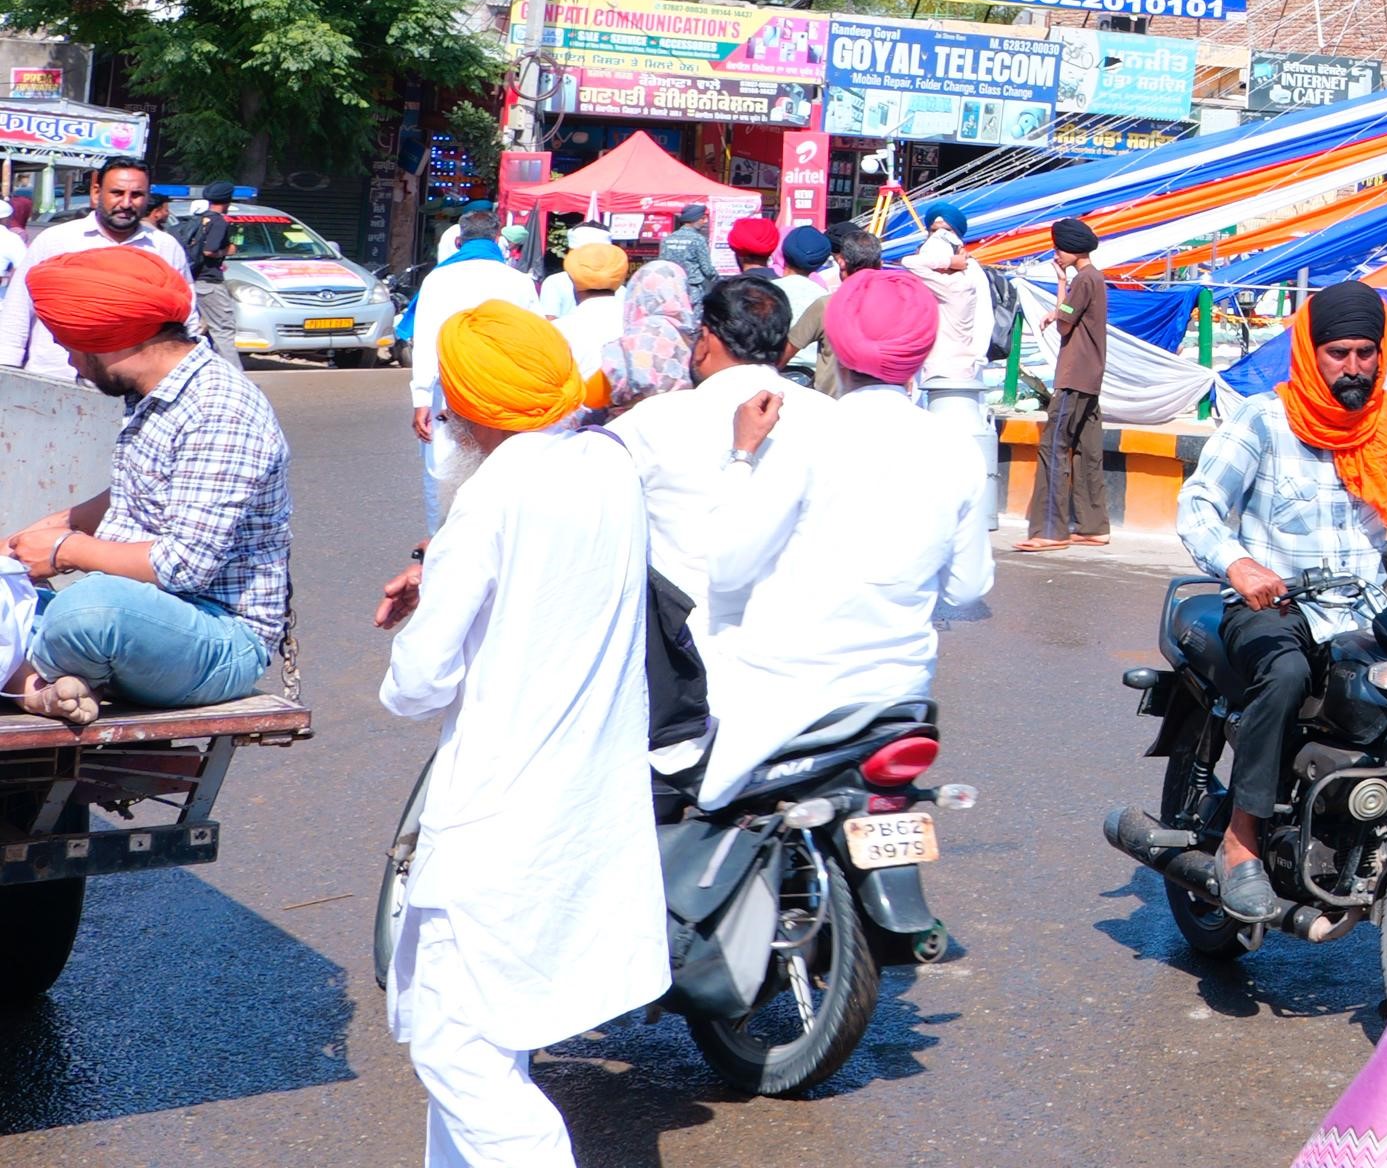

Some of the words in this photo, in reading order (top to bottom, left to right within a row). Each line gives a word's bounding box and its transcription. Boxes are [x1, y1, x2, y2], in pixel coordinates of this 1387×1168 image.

[520, 1, 589, 26] GNPATI
[593, 8, 741, 39] COMMUNICATION'S
[831, 23, 871, 39] Randeep
[873, 26, 901, 41] Goyal
[990, 38, 1001, 50] M.
[1003, 40, 1060, 56] 62832-00030
[832, 36, 925, 77] GOYAL
[934, 45, 1056, 88] TELECOM
[852, 72, 882, 86] Mobile
[884, 74, 913, 90] Repair,
[915, 77, 942, 91] Folder
[944, 80, 977, 96] Change,
[979, 82, 1001, 96] Glass
[1003, 85, 1033, 100] Change
[1281, 73, 1348, 90] INTERNET
[579, 85, 646, 106] ਗਣਪਤੀ
[1292, 87, 1335, 105] CAFE
[784, 168, 826, 184] airtel
